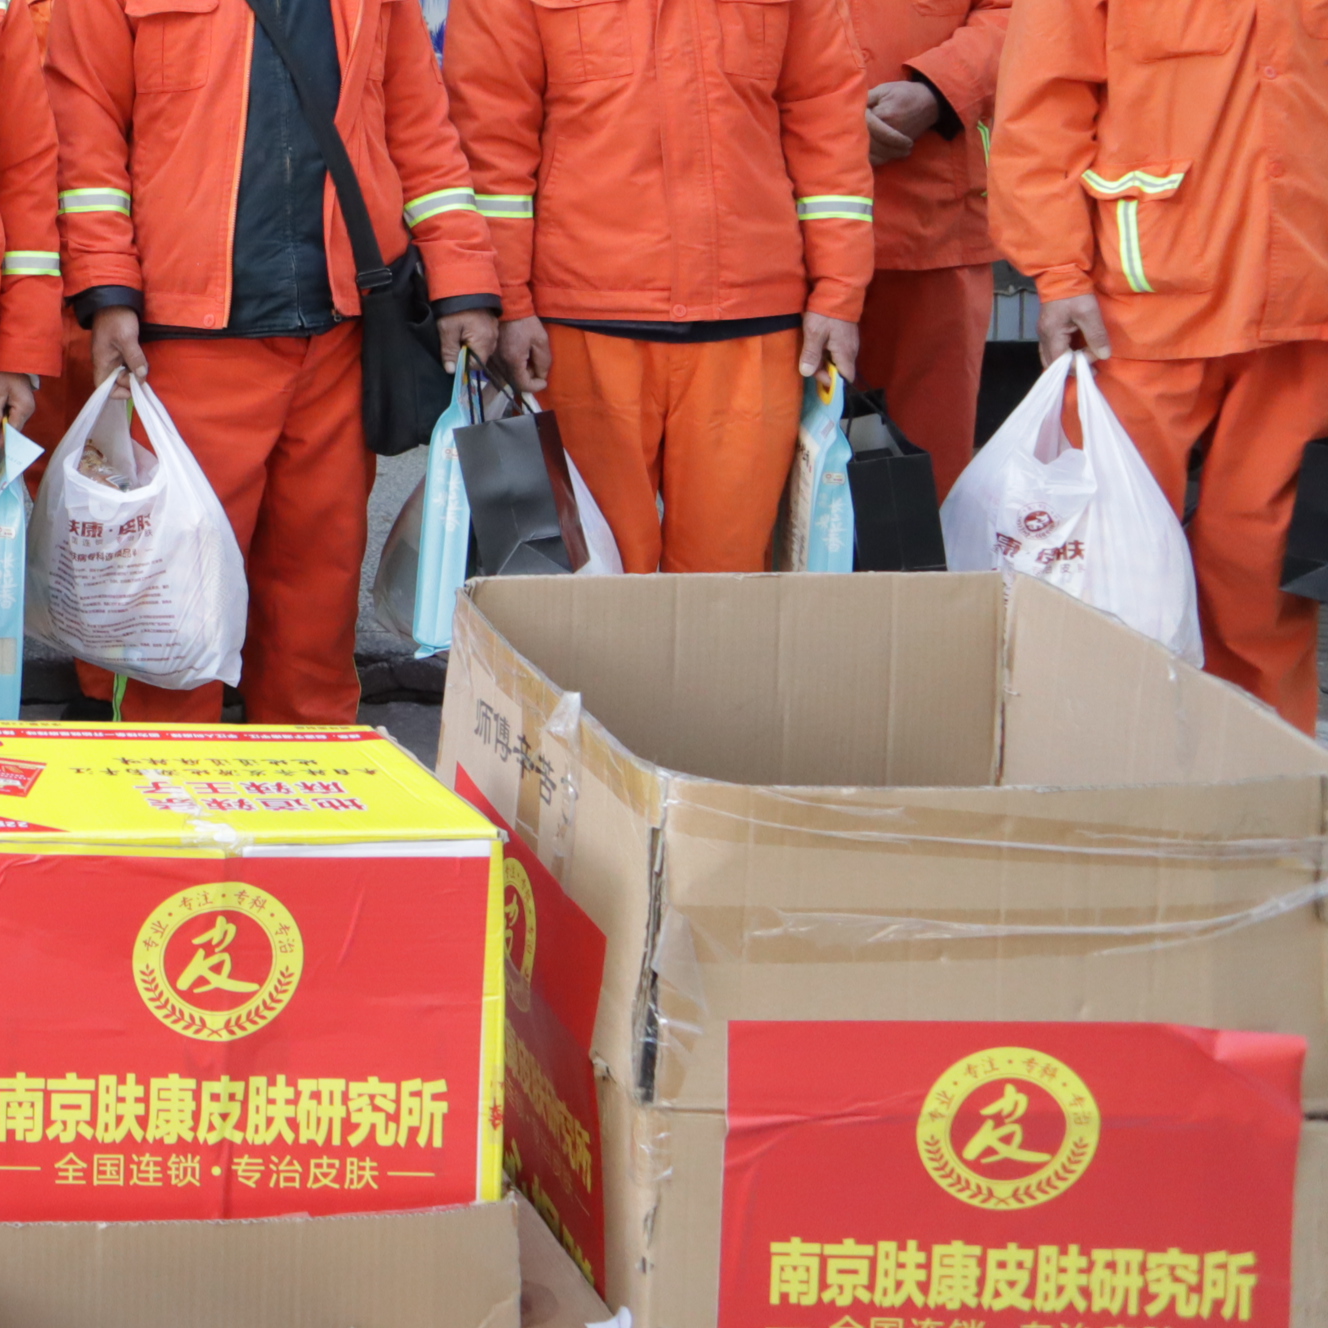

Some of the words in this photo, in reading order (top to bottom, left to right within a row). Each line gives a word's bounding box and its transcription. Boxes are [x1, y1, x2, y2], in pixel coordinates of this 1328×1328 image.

[52, 1153, 380, 1191] 全国连锁·专治皮肤
[767, 1236, 1258, 1324] 南京肤康皮肤研究所
